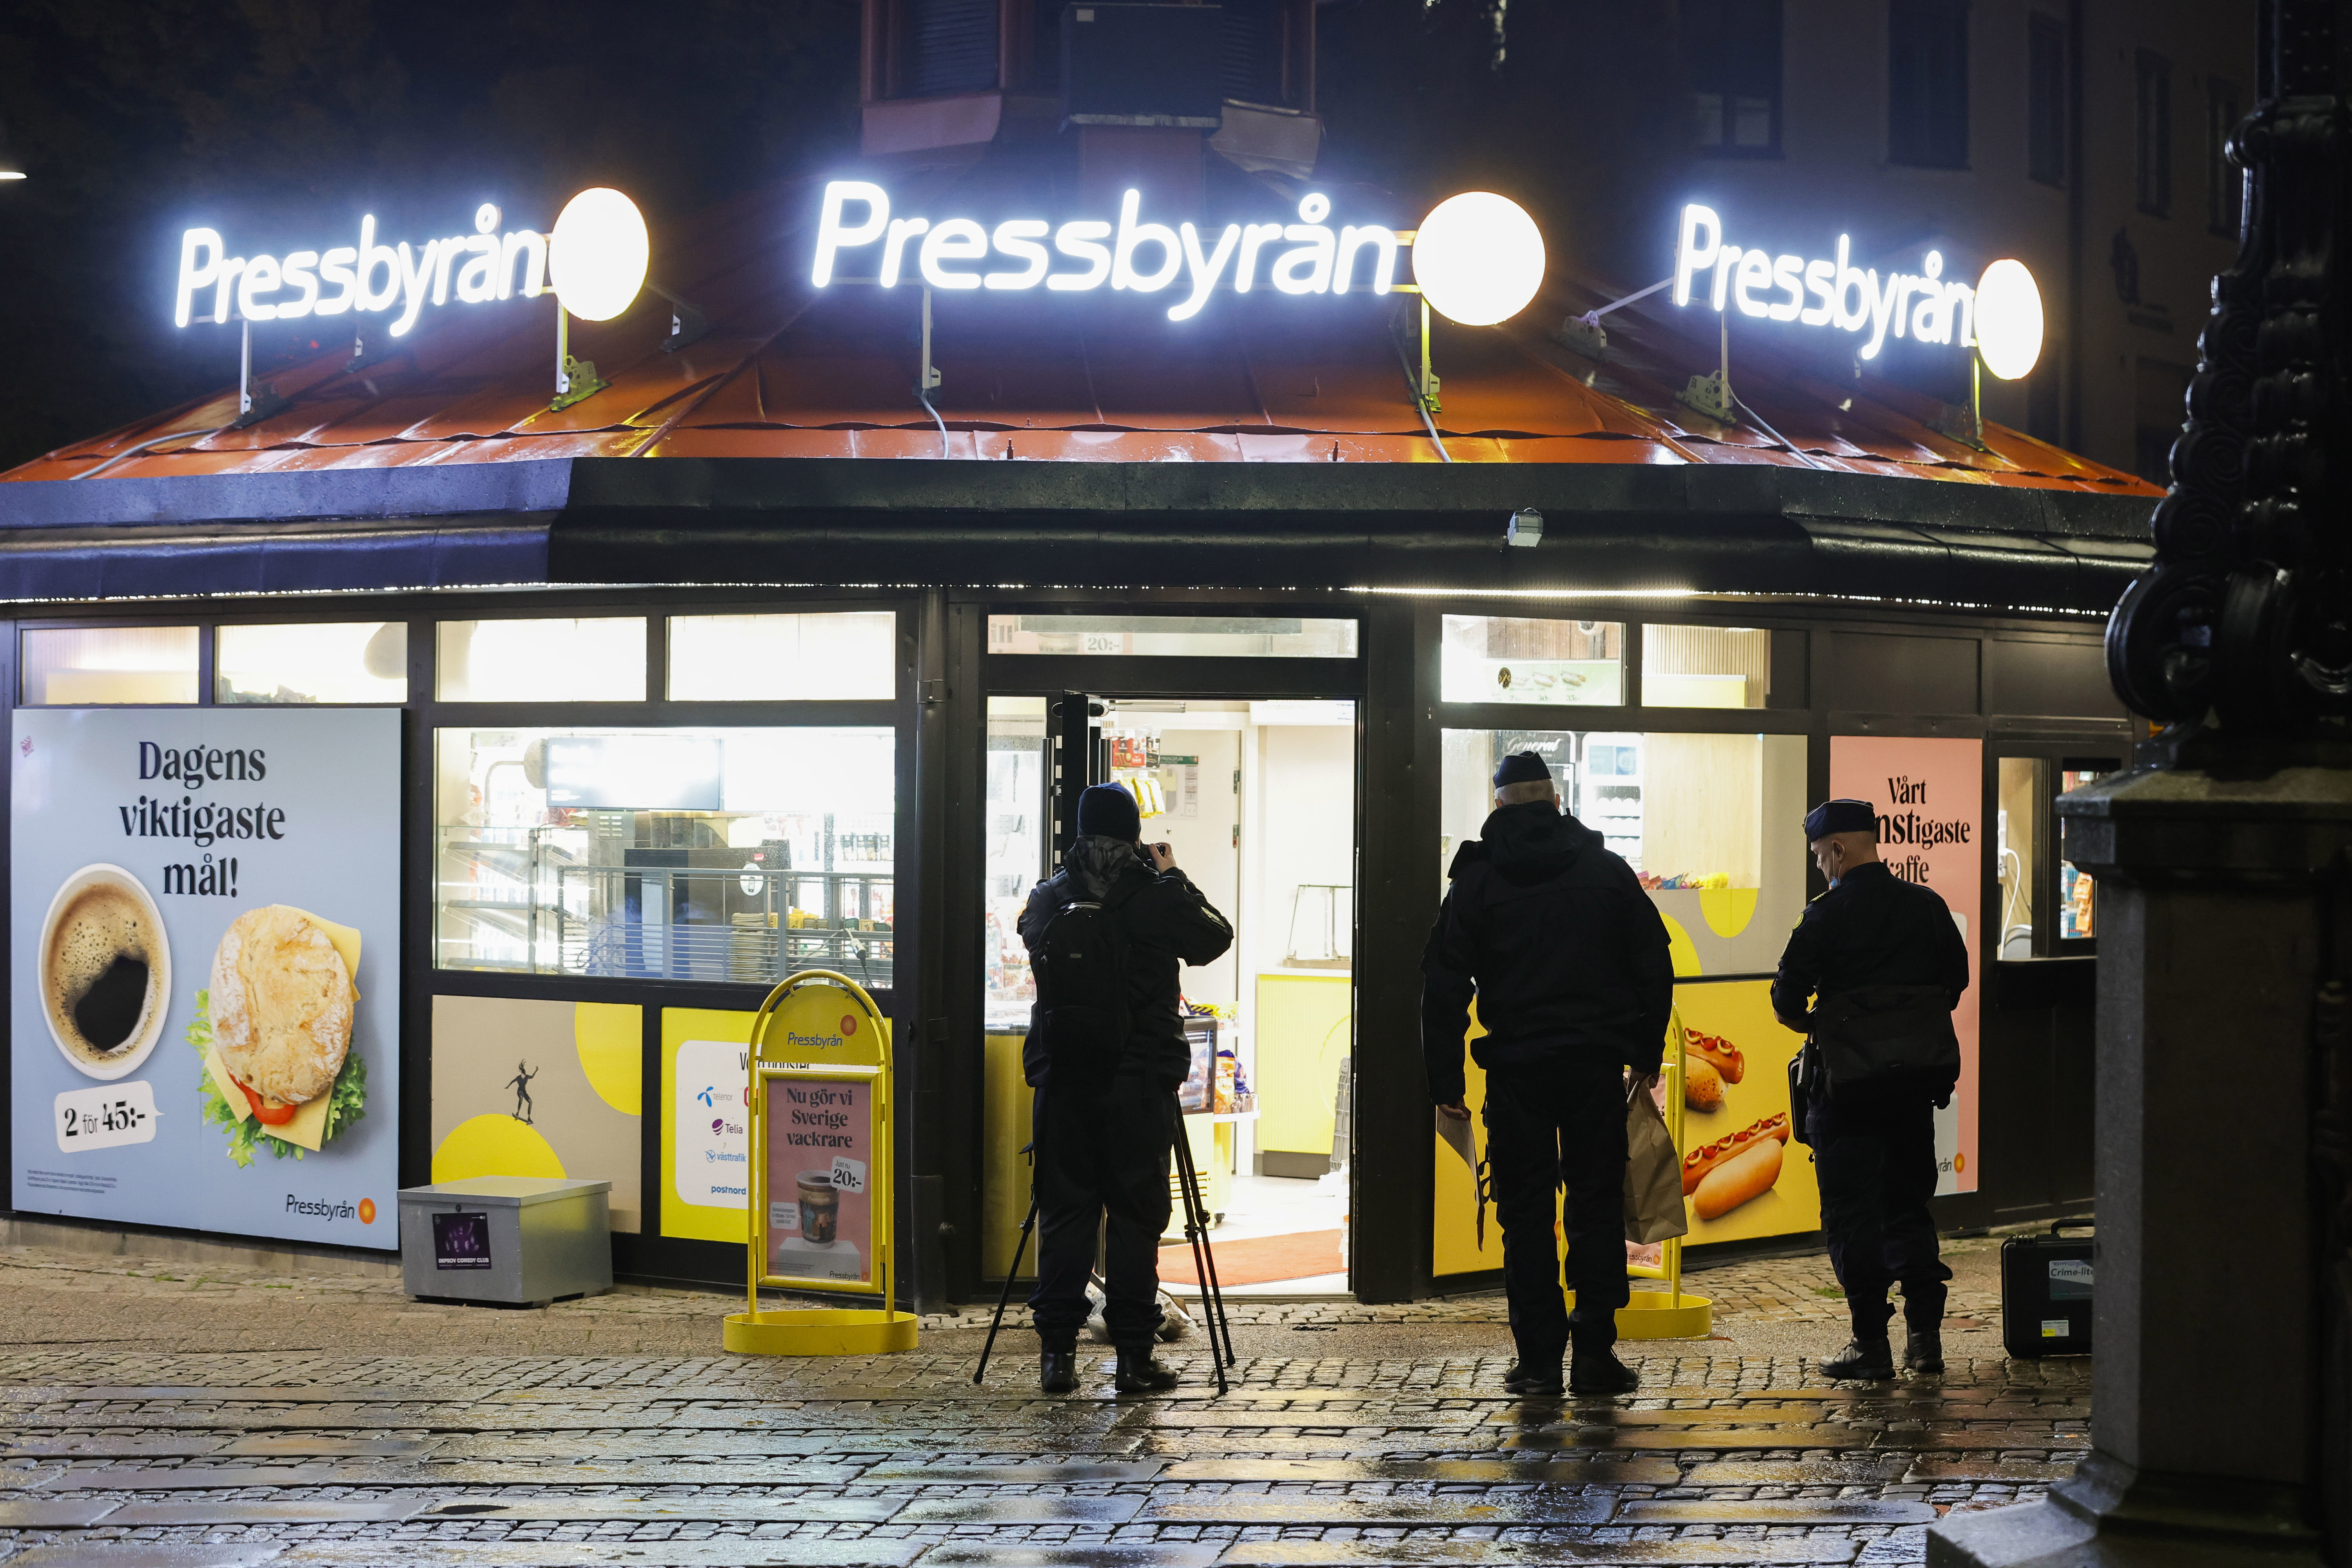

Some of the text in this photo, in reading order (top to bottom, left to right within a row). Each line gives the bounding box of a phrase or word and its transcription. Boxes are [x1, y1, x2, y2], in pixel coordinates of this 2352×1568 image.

[811, 180, 1397, 323] Pressbyrån
[175, 203, 548, 338] Pressbyrån
[1672, 203, 1976, 360] Pressbyrån
[1088, 637, 1120, 651] 20:-
[1505, 735, 1563, 753] General
[139, 740, 266, 789] Dagens
[1888, 775, 1926, 804] Vårt
[120, 796, 285, 846] viktigaste
[1876, 808, 1970, 850] nstigaste
[163, 854, 238, 897] mål!
[788, 1032, 843, 1049] Pressbyrån
[787, 1088, 852, 1107] Nu gör vi
[65, 1102, 146, 1137] 2 för 45:-
[725, 1123, 743, 1134] Telia
[792, 1109, 848, 1129] Sverige
[787, 1132, 853, 1148] vackrare
[717, 1152, 746, 1162] västtrafik
[833, 1169, 862, 1187] 20:-
[711, 1186, 746, 1195] postnord
[286, 1194, 354, 1221] Pressbyrån
[1627, 1253, 1652, 1263] essbyrån
[829, 1270, 860, 1281] Pressbyrån
